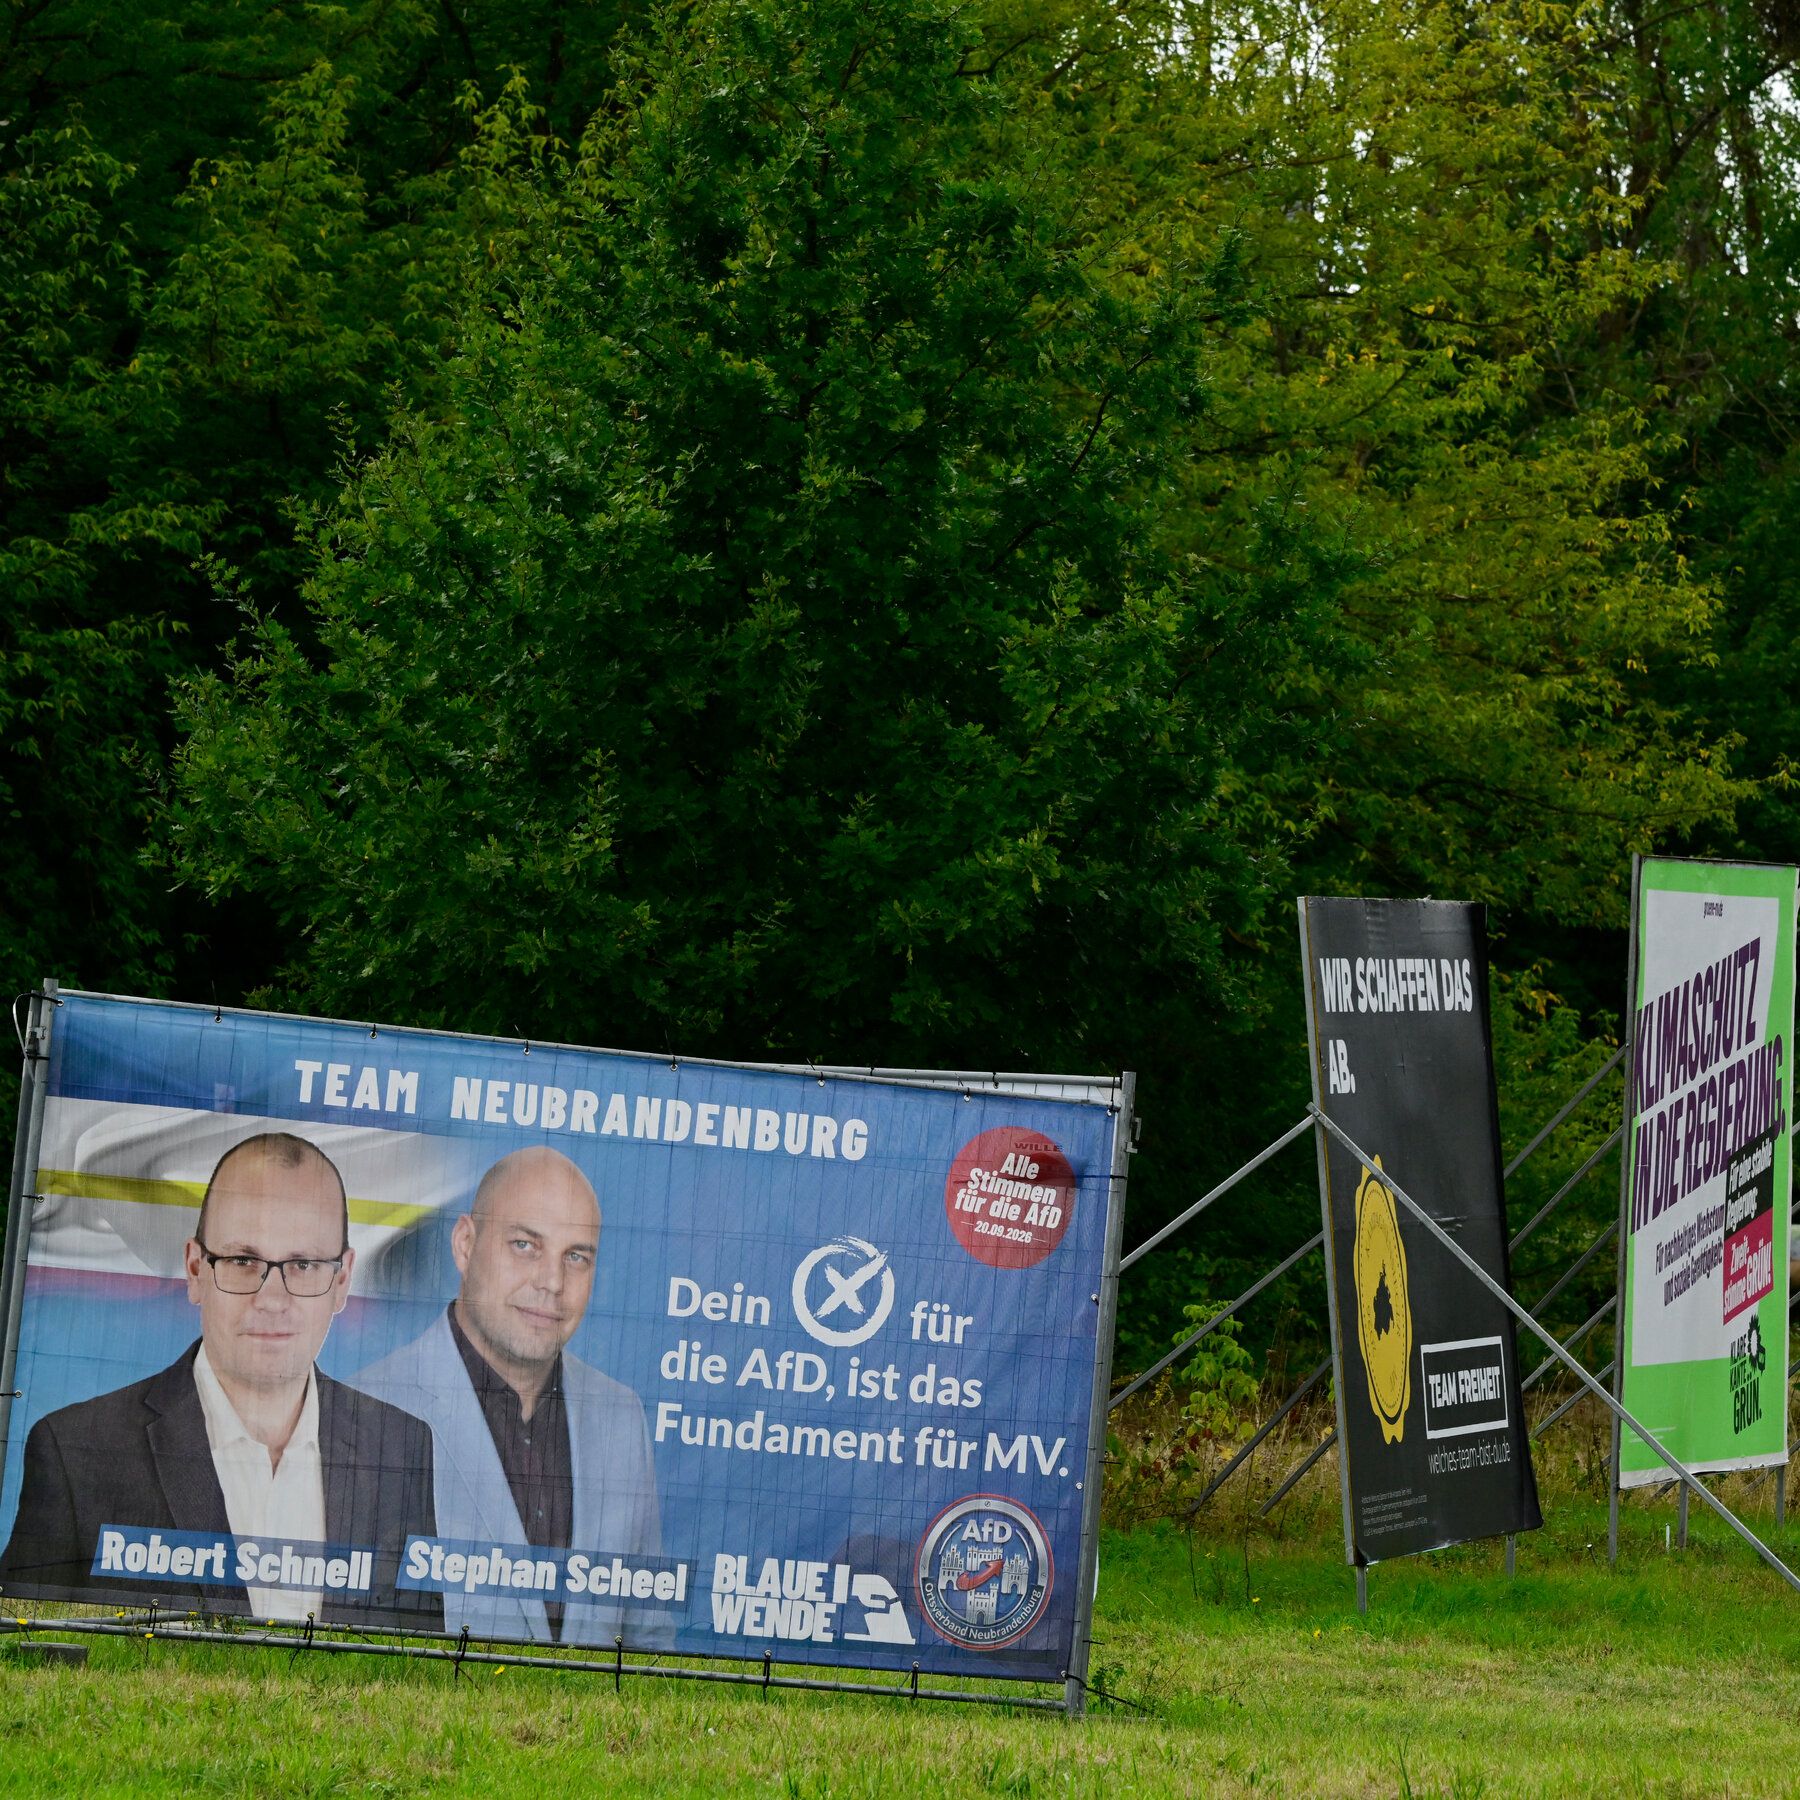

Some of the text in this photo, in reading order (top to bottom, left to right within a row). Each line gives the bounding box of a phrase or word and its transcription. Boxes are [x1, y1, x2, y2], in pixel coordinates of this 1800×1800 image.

[1319, 957, 1472, 1013] WIR SCHAFFEN DAS
[1634, 937, 1760, 1116] KLIMASCHUTZ
[1328, 1039, 1356, 1094] AB.
[295, 1060, 868, 1161] TEAM NEUBRANDENBURG
[1631, 1034, 1785, 1234] IN DIE REGIERUNG.
[967, 1168, 1056, 1205] Stimmen
[1000, 1153, 1040, 1179] Alle
[955, 1189, 1062, 1229] für die AfD
[975, 1221, 1033, 1243] 20.09.2026
[1746, 1238, 1772, 1299] GRÜN!
[667, 1276, 973, 1344] Dein für
[659, 1342, 983, 1408] die AfD, ist das
[1428, 1371, 1458, 1408] TEAM
[1458, 1366, 1500, 1403] FREIHEIT
[1734, 1372, 1762, 1434] GRÜN.
[655, 1402, 1069, 1477] Fundament für MV.
[961, 1518, 1013, 1544] AfD
[101, 1531, 372, 1590] Robert Schnell
[406, 1542, 687, 1602] Stephan Scheel
[712, 1553, 829, 1602] BLAUE
[711, 1593, 837, 1642] WENDE
[925, 1582, 1042, 1640] Ortsverband Neubrandenburg
